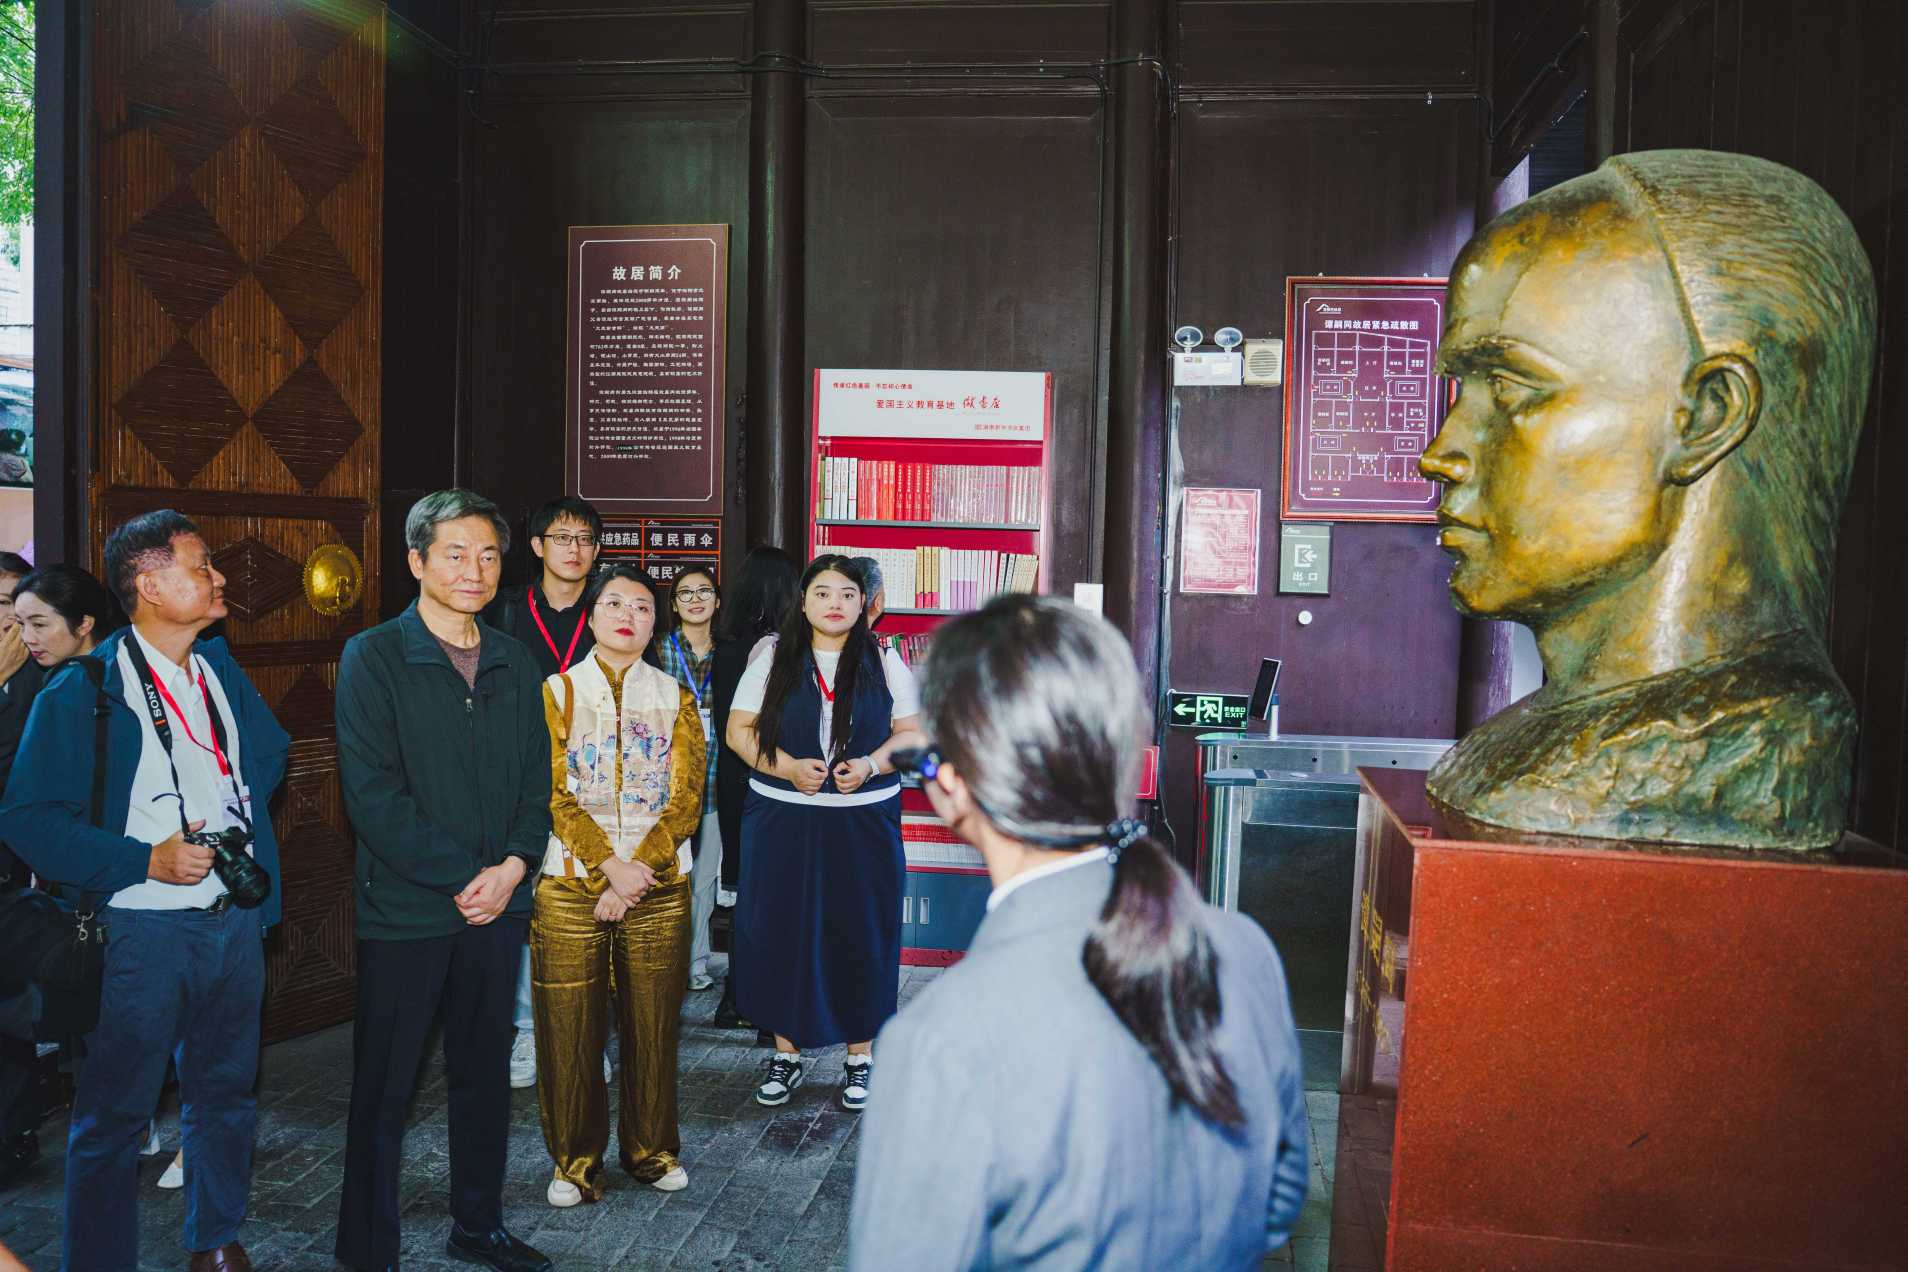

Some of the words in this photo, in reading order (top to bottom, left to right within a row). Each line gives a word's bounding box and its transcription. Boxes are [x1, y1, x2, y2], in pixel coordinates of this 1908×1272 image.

[612, 265, 682, 281] 故居简介
[875, 399, 956, 410] 爱国主义教育基地
[650, 533, 713, 547] 便民雨伞
[1292, 571, 1318, 581] 出口
[145, 682, 163, 718] SONY
